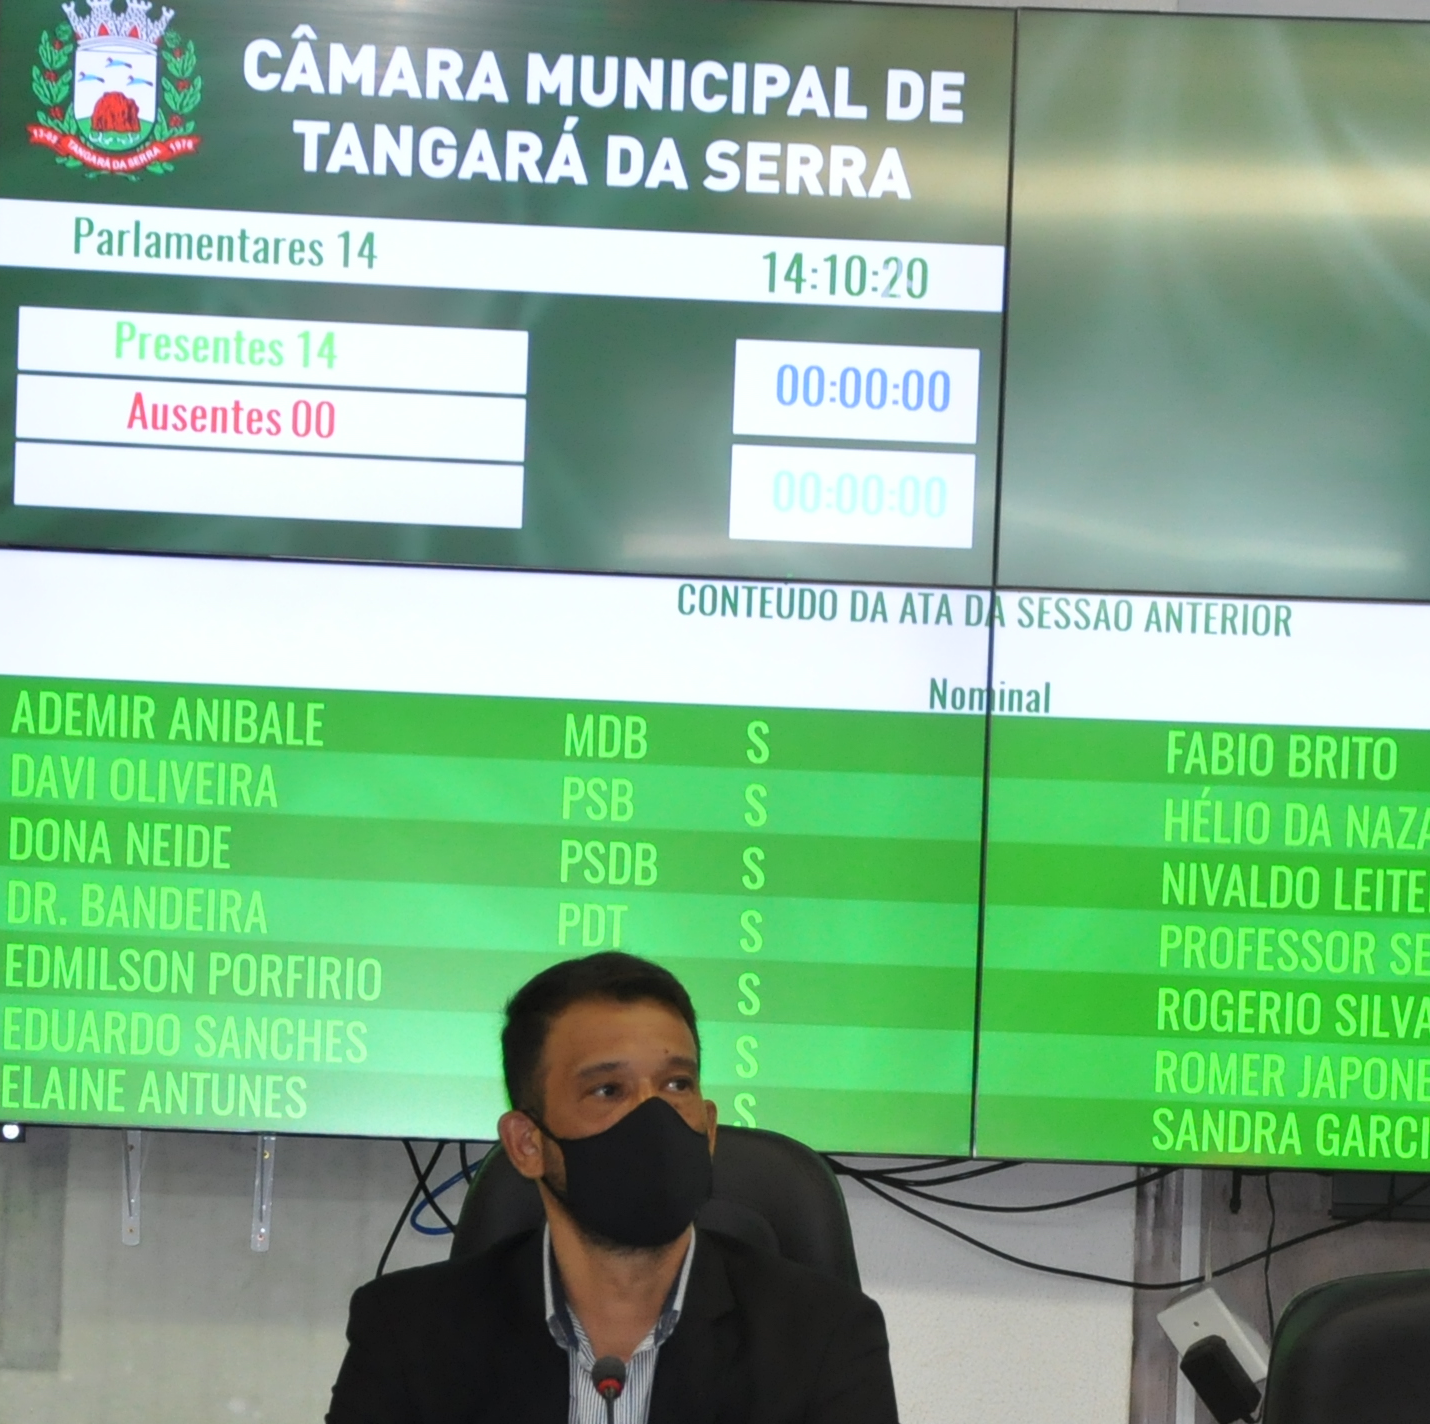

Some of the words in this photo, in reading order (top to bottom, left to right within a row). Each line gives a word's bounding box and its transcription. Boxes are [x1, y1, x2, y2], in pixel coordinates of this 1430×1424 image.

[243, 24, 508, 105] CÂMARA
[526, 53, 868, 120] MUNICIPAL
[886, 70, 965, 124] DE
[112, 160, 127, 170] DA
[128, 147, 161, 168] SERRA
[292, 117, 586, 186] TANGARÁ
[606, 134, 688, 190] DA
[703, 140, 912, 199] SERRA
[73, 216, 324, 269] Parlamentares
[337, 228, 378, 270] 14
[762, 251, 930, 300] 14:10:20
[114, 320, 285, 368] Presentes
[297, 329, 338, 371] 14
[775, 362, 951, 414] 00:00:00
[127, 391, 282, 439] Ausentes
[291, 399, 336, 440] 00
[772, 469, 947, 519] 00:00:00
[850, 590, 888, 623] DA
[899, 592, 953, 626] ATA
[965, 594, 1006, 628] DA
[1017, 596, 1134, 633] SESSAO
[1145, 599, 1293, 638] ANTERIOR
[929, 677, 1051, 714] Nominal
[12, 688, 157, 741] ADEMIR
[169, 696, 325, 748] ANIBALE
[564, 712, 649, 761] MDB
[746, 719, 770, 766] S
[1166, 729, 1275, 777] FABIO
[1287, 733, 1398, 783] BRITO
[11, 752, 96, 800] DAVI
[109, 756, 278, 809] OLIVEIRA
[561, 775, 635, 823] PSB
[743, 782, 768, 829] S
[1164, 788, 1271, 845] HÉLIO
[1284, 803, 1334, 848] DA
[9, 815, 112, 866] DONA
[125, 821, 232, 871] NEIDE
[559, 838, 659, 887] PSDB
[741, 845, 766, 891] S
[1161, 861, 1321, 913] NIVALDO
[6, 879, 67, 927] DR.
[81, 882, 268, 935] BANDEIRA
[557, 901, 627, 950] PDT
[740, 908, 763, 953] S
[1159, 924, 1375, 976] PROFESSOR
[4, 942, 195, 996] EDMILSON
[208, 949, 382, 1003] PORFIRIO
[737, 972, 761, 1017] S
[1156, 988, 1322, 1038] ROGERIO
[2, 1005, 182, 1058] EDUARDO
[193, 1012, 369, 1065] SANCHES
[735, 1034, 759, 1079] S
[0, 1064, 124, 1113] ELAINE
[138, 1068, 308, 1121] ANTUNES
[1154, 1051, 1285, 1099] ROMER
[1152, 1108, 1302, 1158] SANDRA
